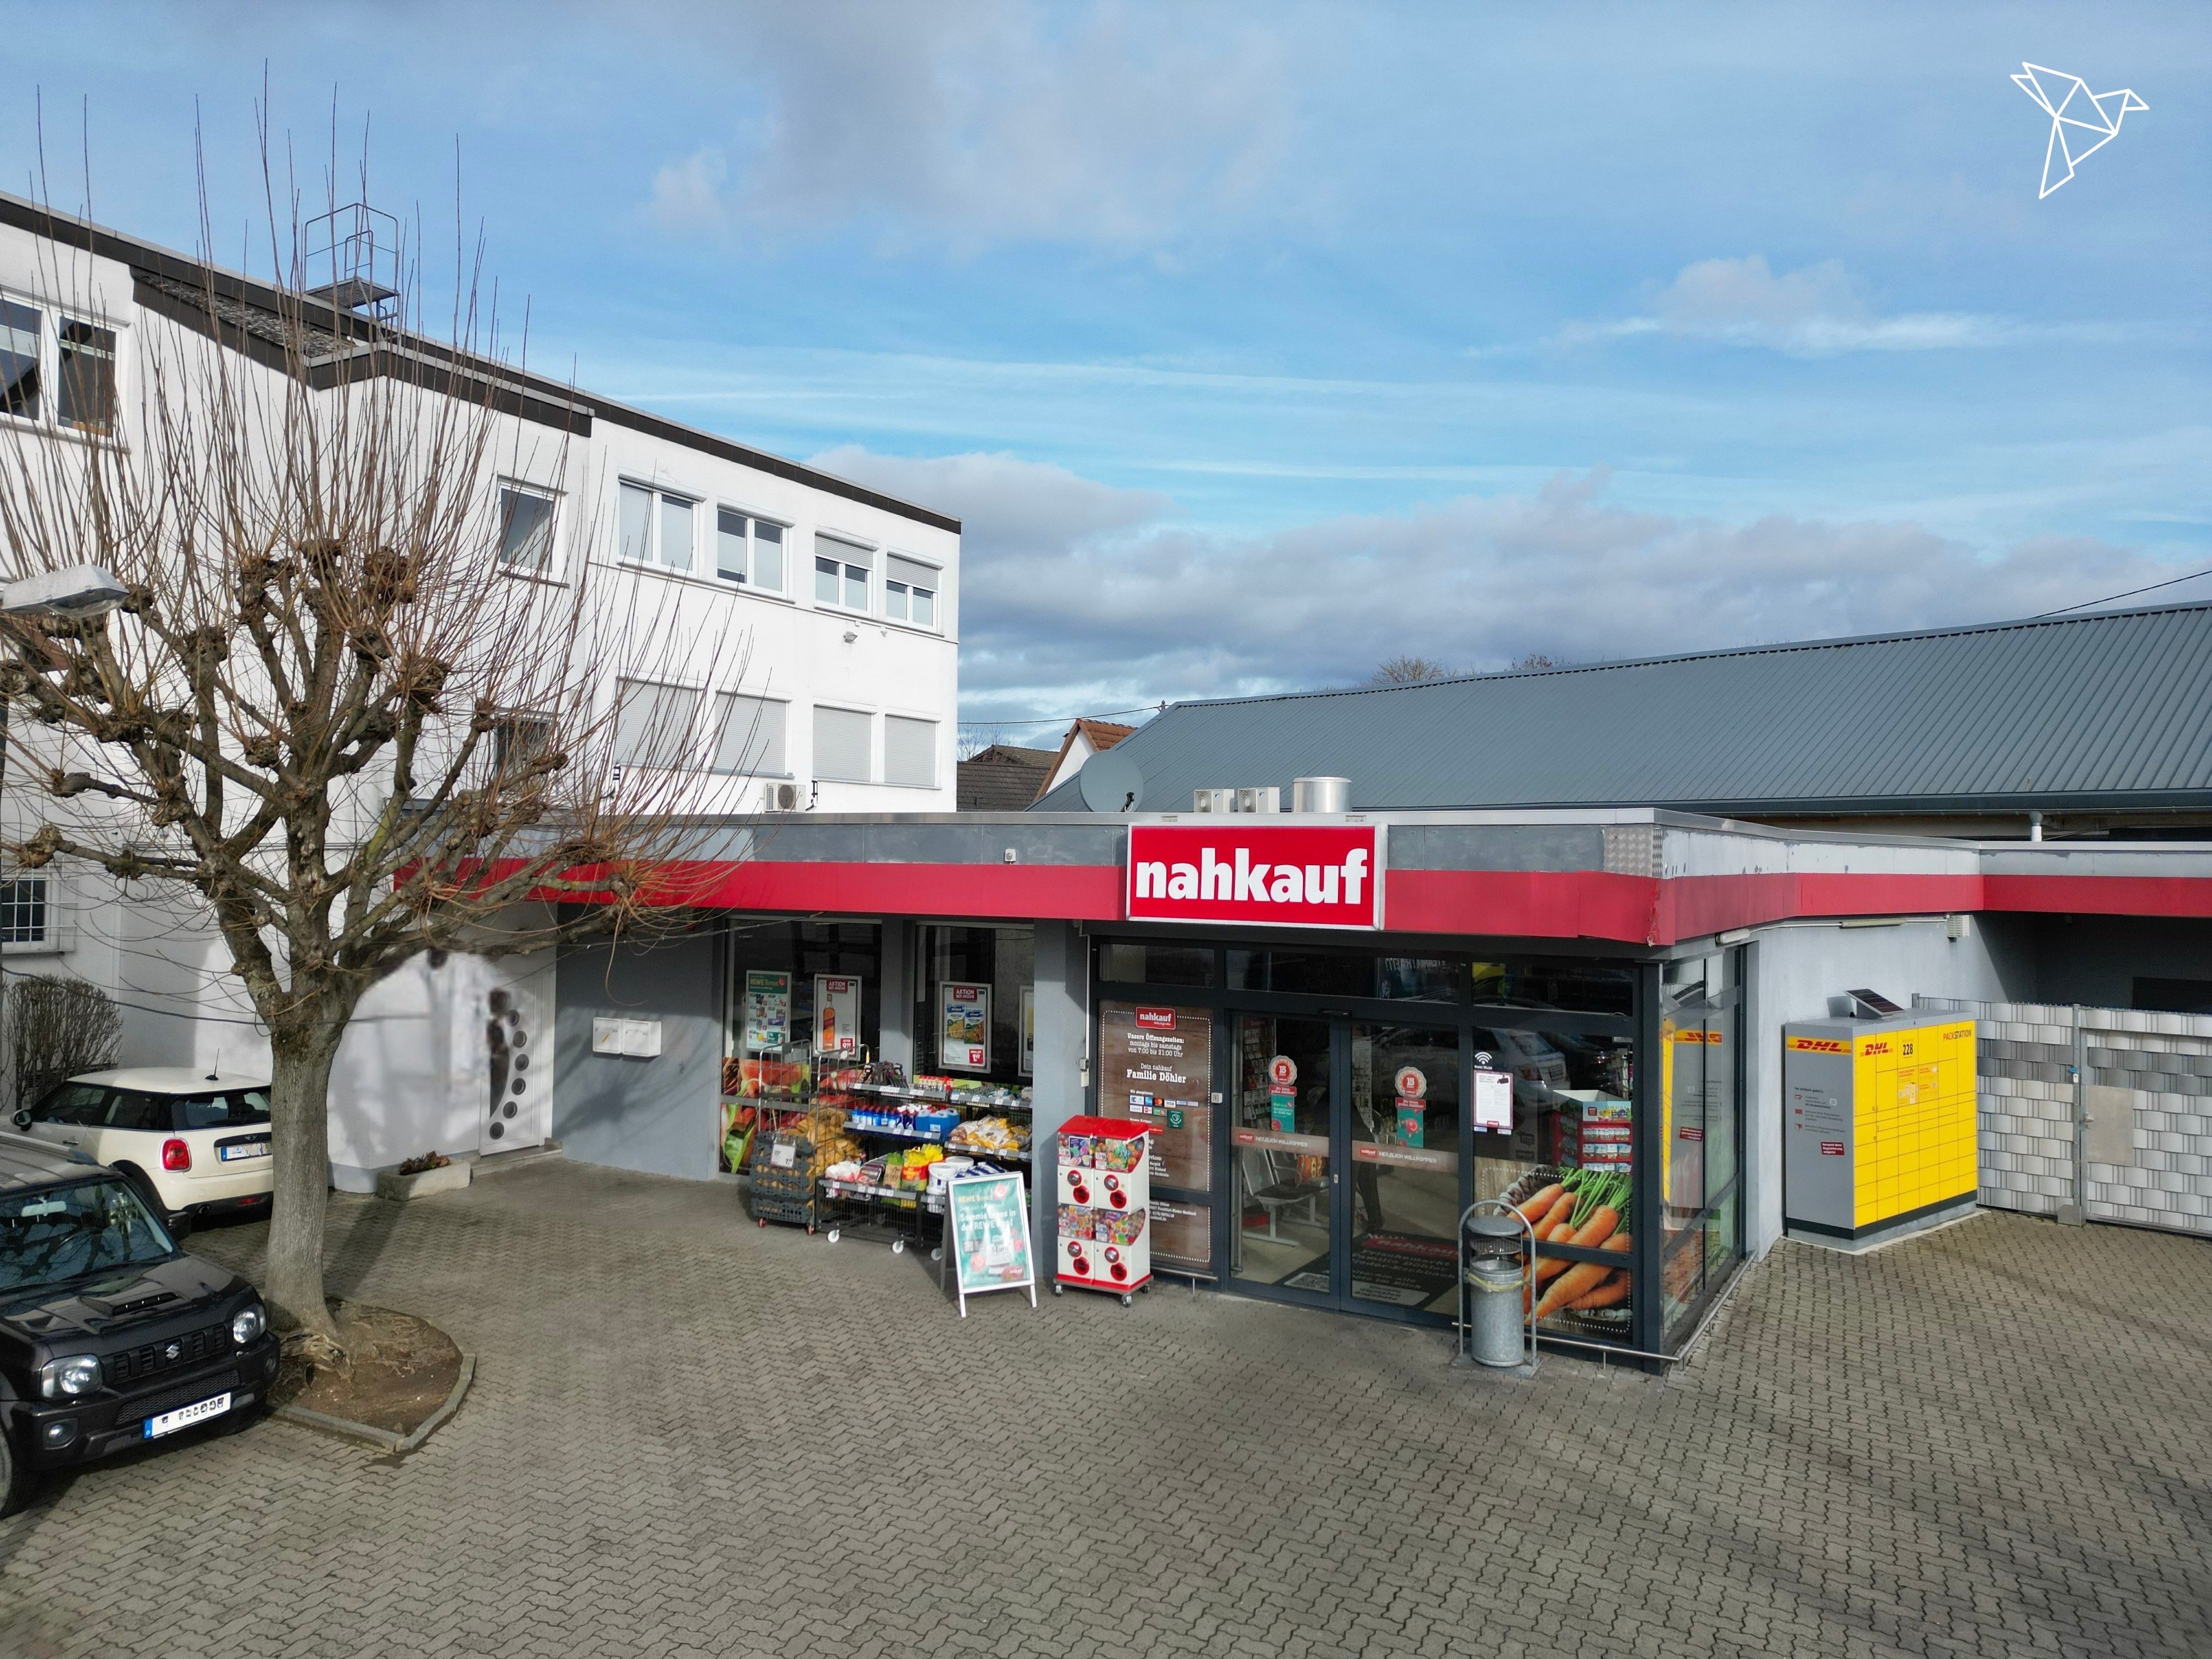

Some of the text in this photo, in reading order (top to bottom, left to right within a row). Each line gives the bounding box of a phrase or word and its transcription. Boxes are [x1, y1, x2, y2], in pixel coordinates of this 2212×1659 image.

[1136, 848, 1368, 904] nahkauf
[1140, 1012, 1171, 1022] nahkauf
[1943, 1029, 1972, 1041] PACKSTATION
[1796, 1040, 1843, 1052] DHL
[1865, 1042, 1889, 1056] DHL
[1903, 1043, 1914, 1056] 228
[1127, 1069, 1186, 1084] Familie Döhler
[1404, 1154, 1437, 1163] WILLKOMMEN
[1009, 1208, 1015, 1216] in
